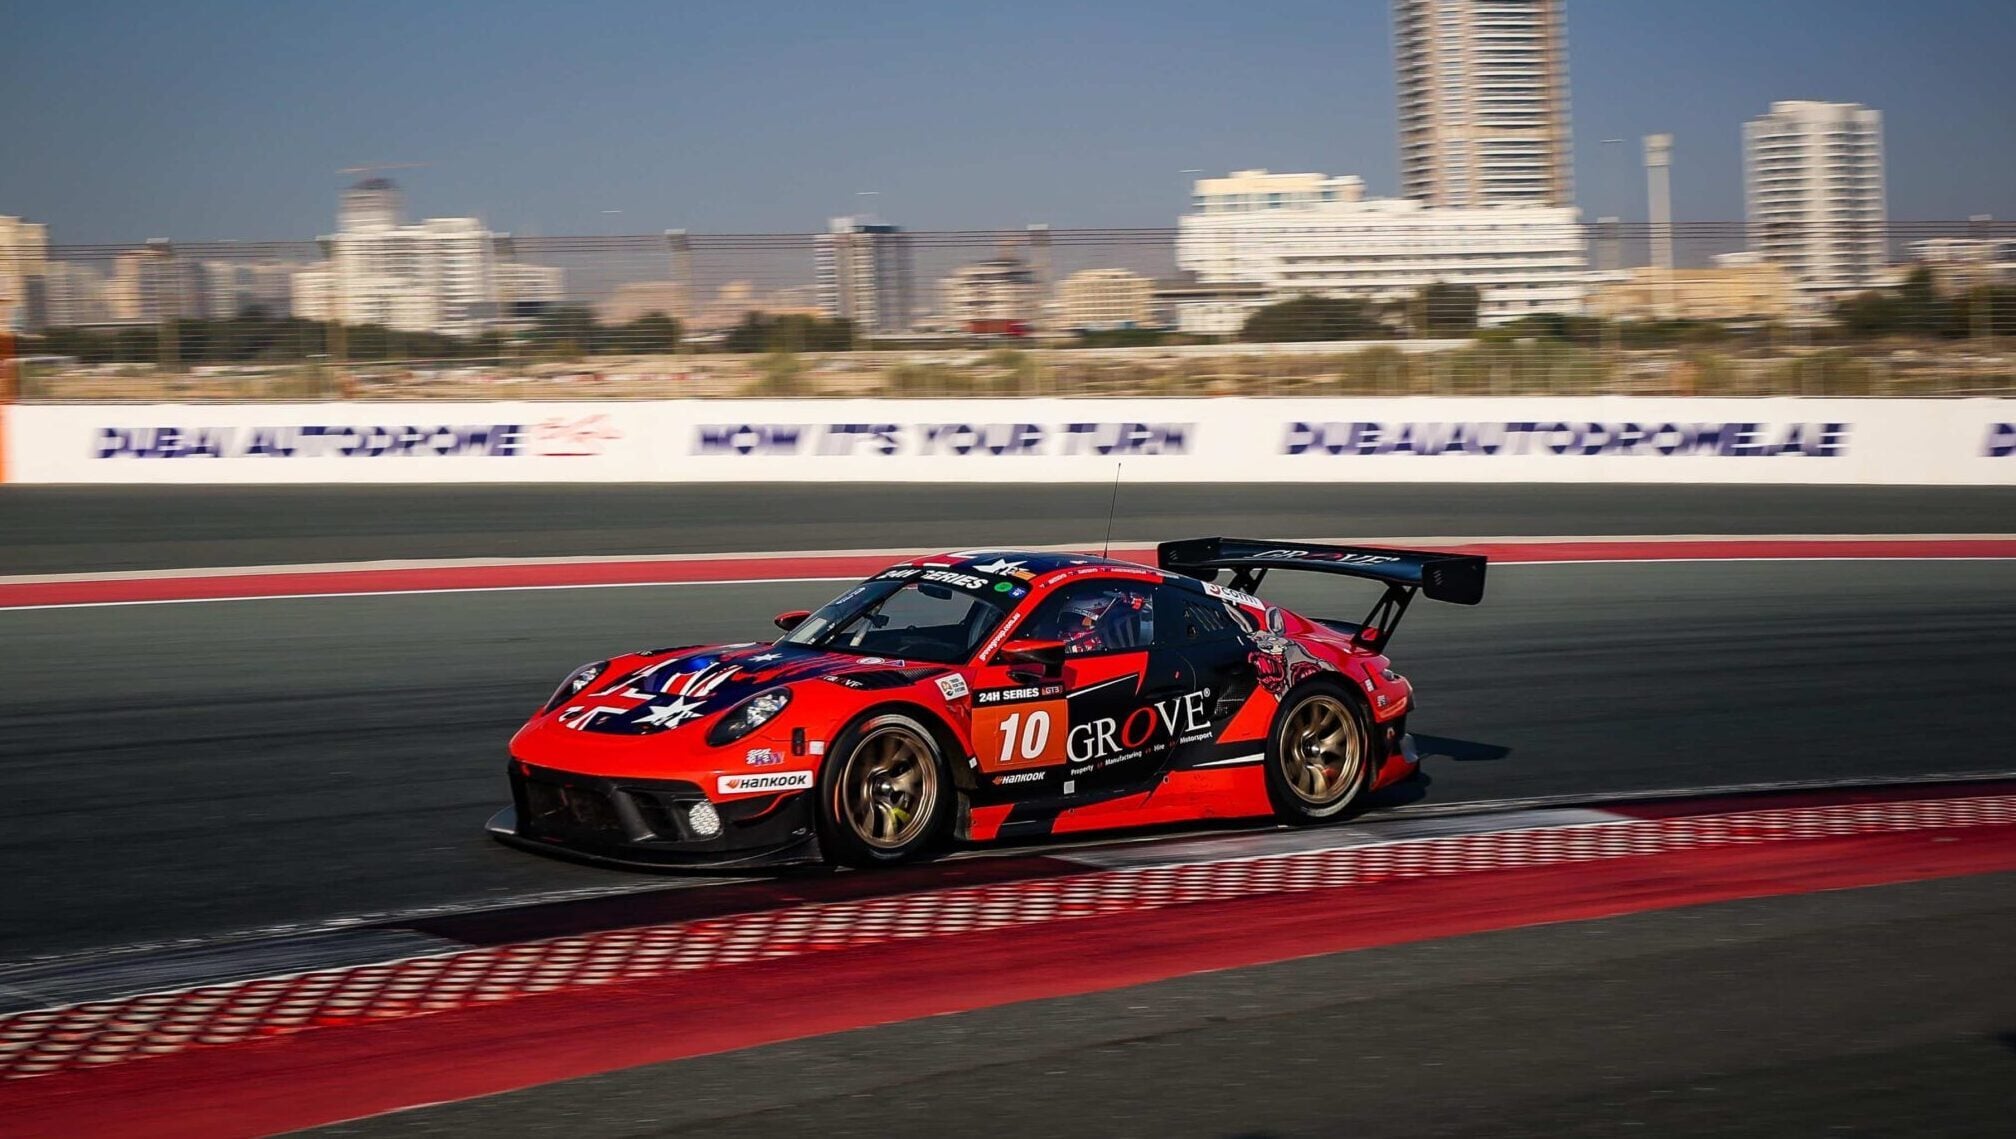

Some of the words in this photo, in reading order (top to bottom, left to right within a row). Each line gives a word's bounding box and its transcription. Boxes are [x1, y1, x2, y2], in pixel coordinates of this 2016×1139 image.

[93, 425, 222, 458] DUBAI
[232, 425, 527, 458] AUTODROME
[691, 423, 805, 456] NOW
[916, 423, 1049, 456] YOUR
[1061, 423, 1198, 456] TURN
[1281, 422, 1850, 456] DUBAIAUTODROME.AE
[920, 570, 990, 590] SERIES
[979, 691, 1001, 703] 24H
[1002, 687, 1040, 700] SERIES
[1000, 710, 1051, 762] 10
[1070, 764, 1095, 776] Property
[1104, 751, 1143, 766] Manufacturing
[1153, 743, 1166, 752] Hire
[1179, 731, 1214, 744] Motorsport
